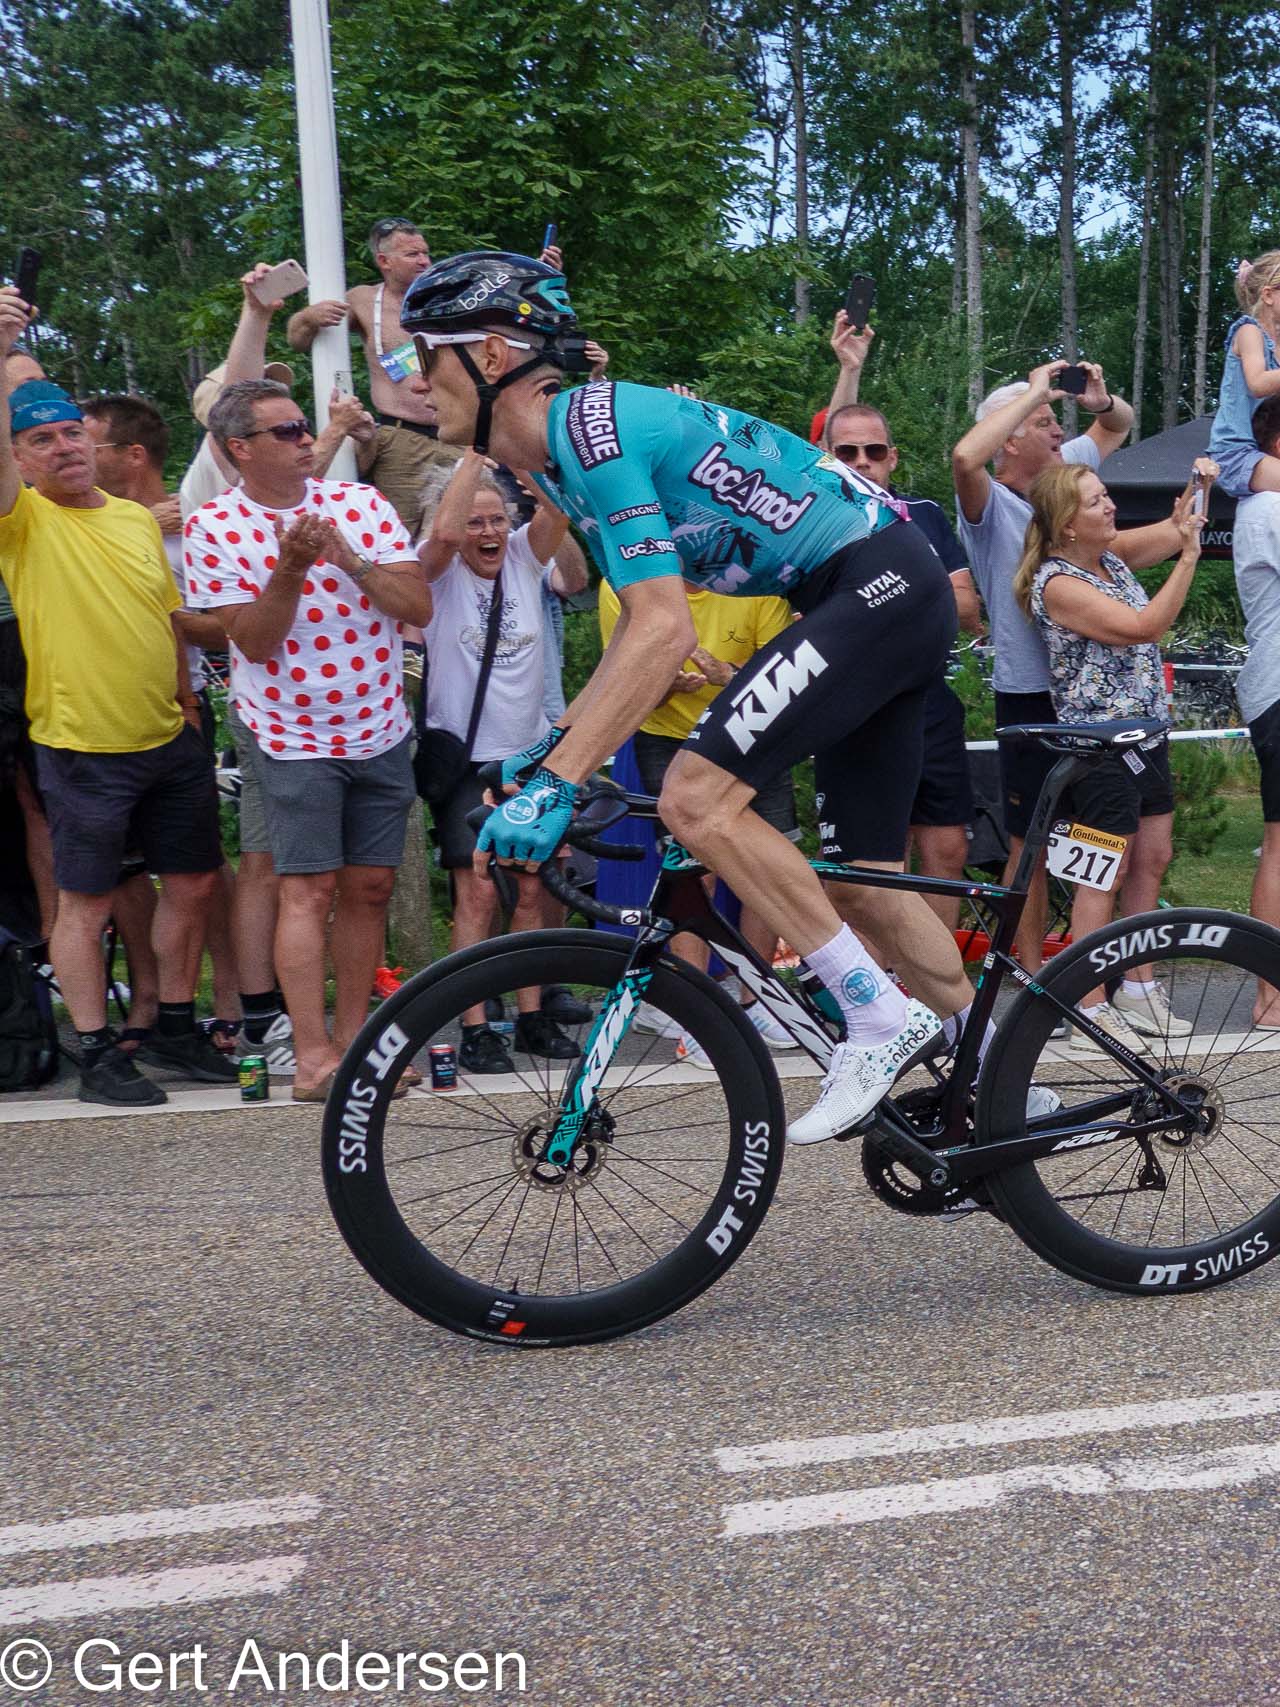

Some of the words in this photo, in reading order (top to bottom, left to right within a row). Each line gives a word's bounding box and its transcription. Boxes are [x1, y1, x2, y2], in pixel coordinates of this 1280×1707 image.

[856, 570, 901, 599] VITAL
[867, 579, 910, 608] concept
[724, 639, 829, 755] KTM
[1072, 828, 1119, 849] Continental
[1061, 846, 1116, 885] 217
[1089, 925, 1174, 973] SWISS
[1179, 924, 1231, 948] DT
[366, 1022, 410, 1081] DT
[581, 987, 634, 1111] KTM
[892, 1023, 931, 1064] nimbl
[339, 1078, 377, 1173] SWISS
[1051, 1129, 1121, 1150] KTM
[705, 1204, 743, 1256] DT
[734, 1121, 770, 1206] SWISS
[1139, 1264, 1187, 1285] DT
[1193, 1231, 1270, 1281] SWISS
